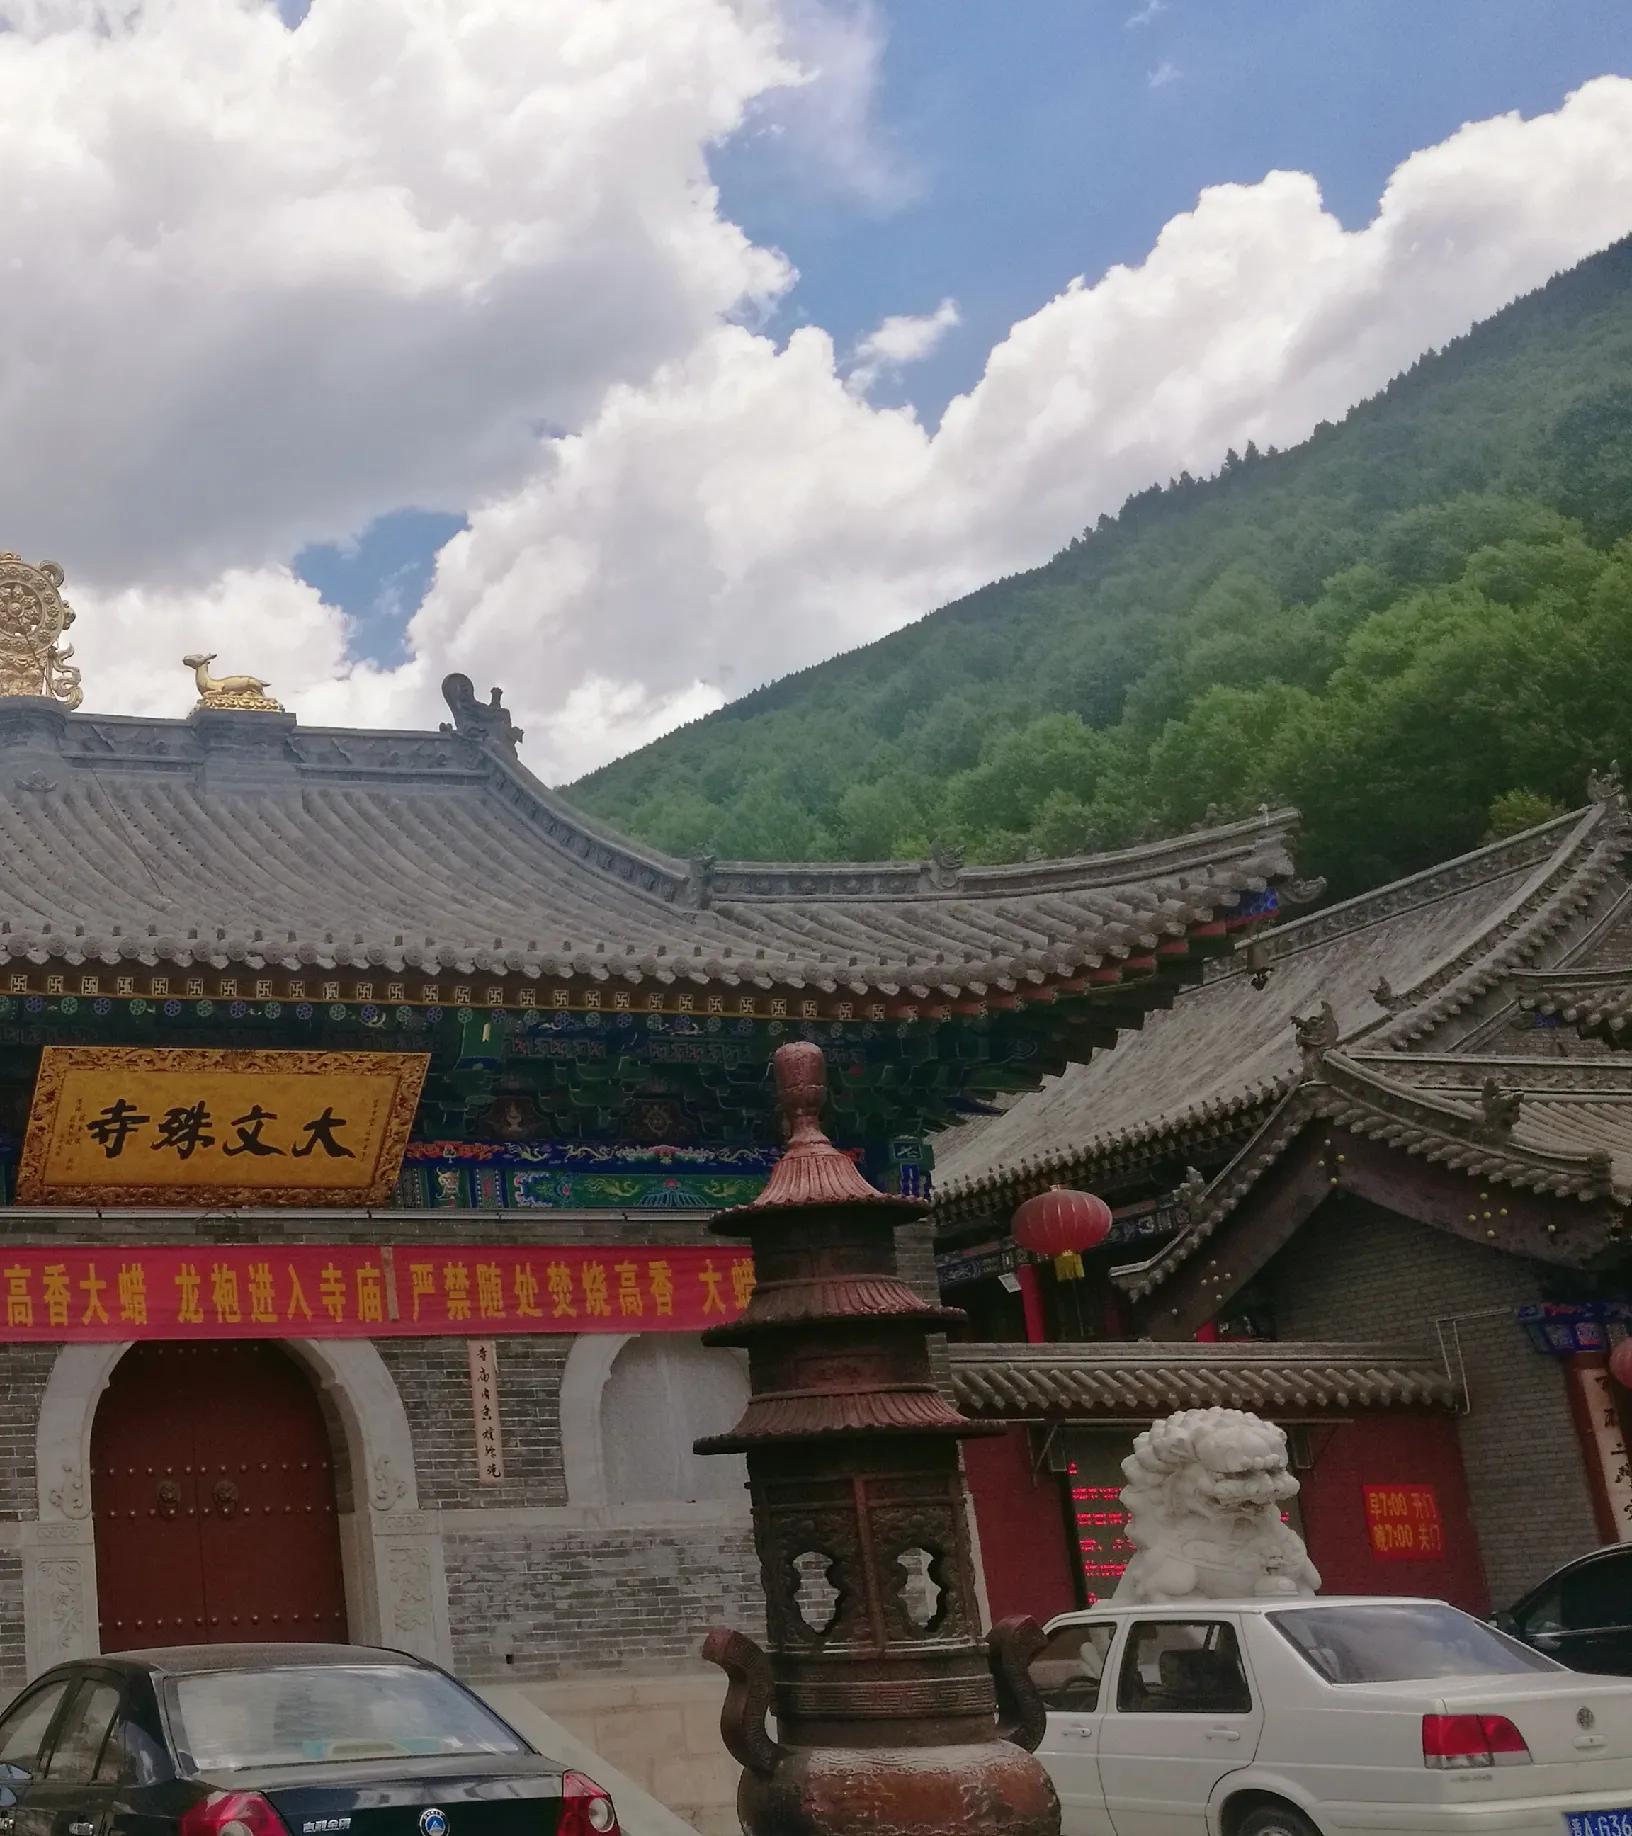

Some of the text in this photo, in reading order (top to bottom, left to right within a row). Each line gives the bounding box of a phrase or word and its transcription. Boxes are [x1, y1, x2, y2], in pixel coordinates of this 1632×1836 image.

[175, 1261, 383, 1323] 龙袍进入寺庙
[1369, 1492, 1437, 1520] 早7:00 开门
[1418, 1523, 1441, 1551] 关门
